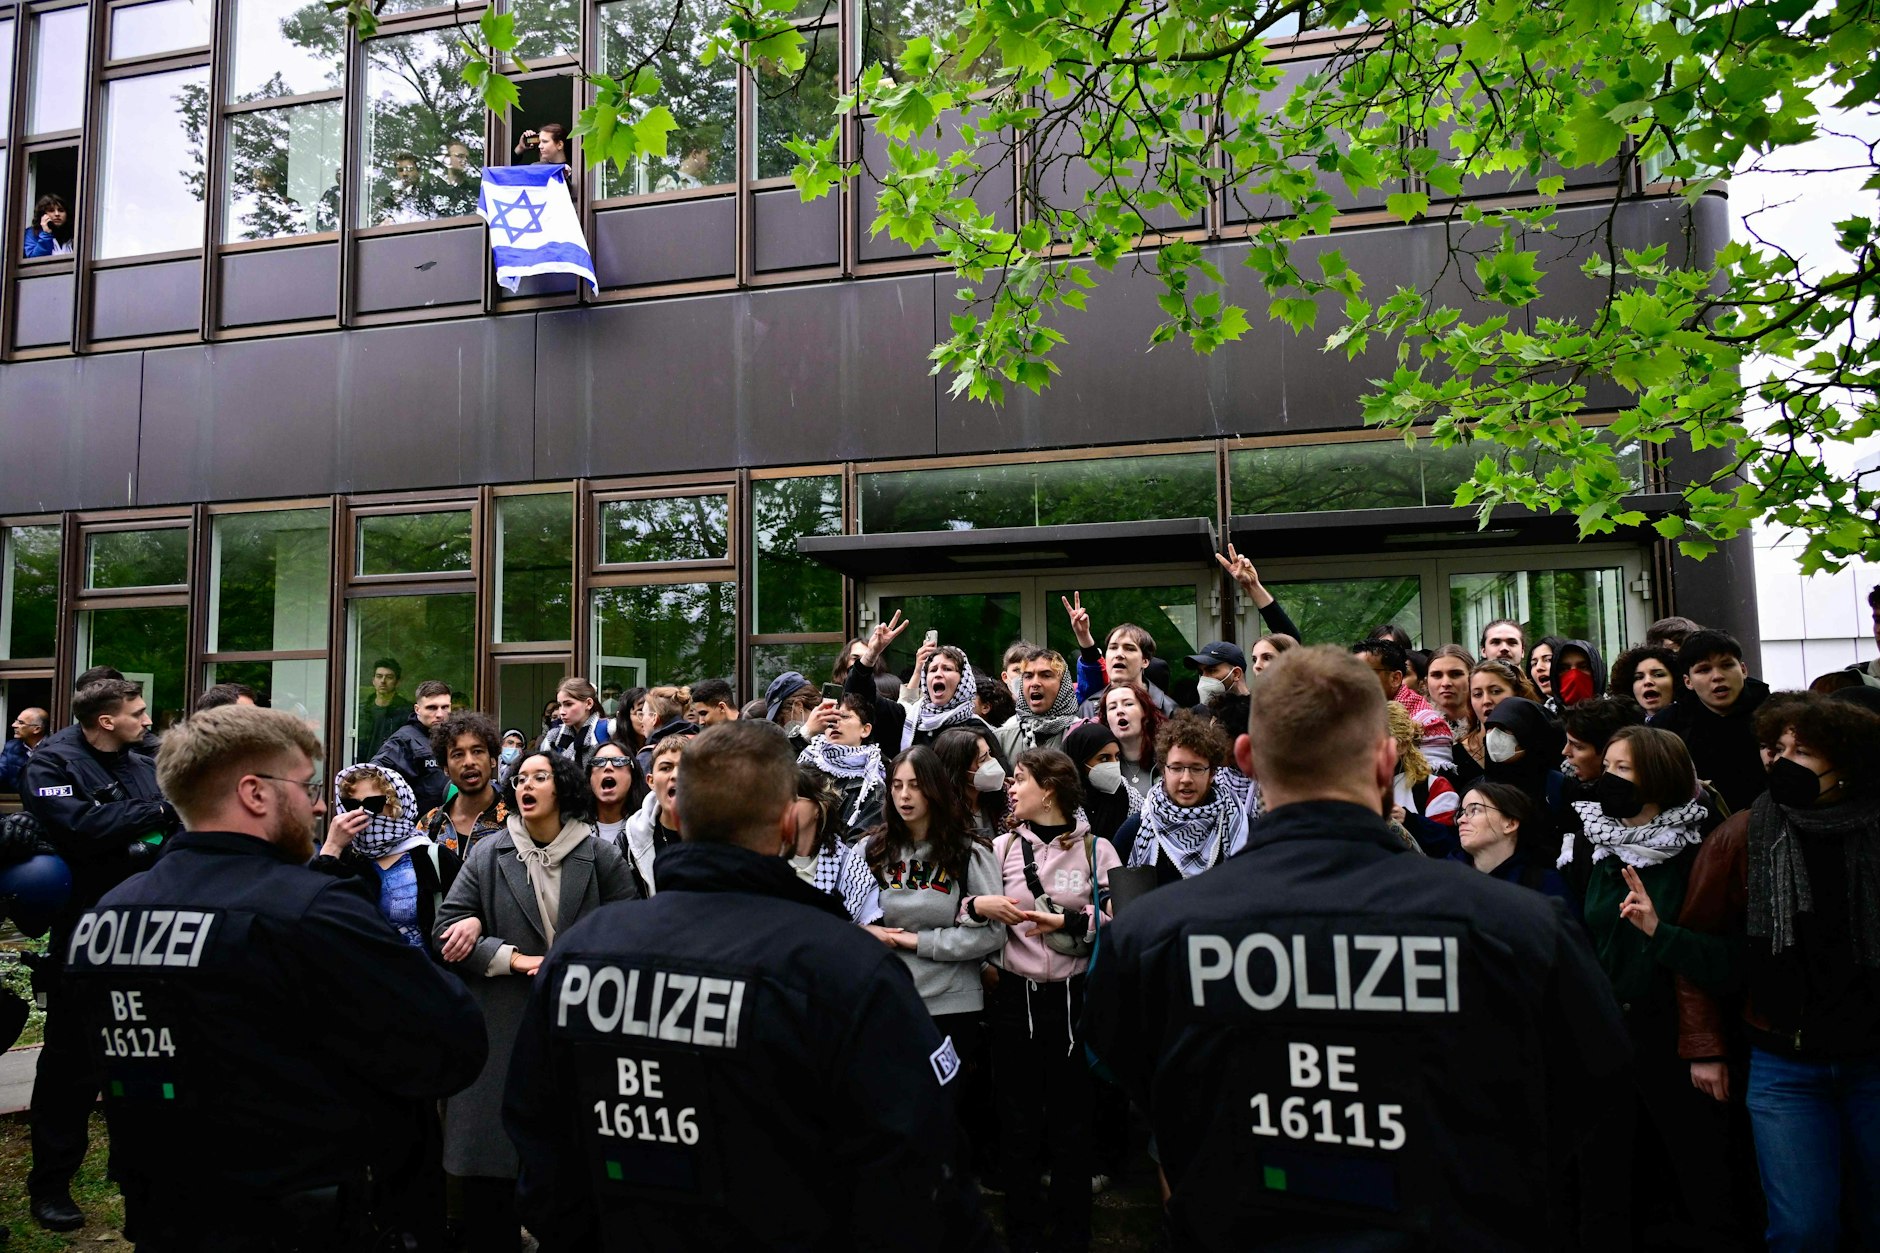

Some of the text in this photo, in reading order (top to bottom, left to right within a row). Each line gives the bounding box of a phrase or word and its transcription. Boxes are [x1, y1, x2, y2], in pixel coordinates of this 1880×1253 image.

[424, 759, 439, 768] POL
[45, 786, 68, 796] BFE
[68, 909, 215, 967] POLIZEI
[1187, 932, 1460, 1013] POLIZEI
[110, 990, 147, 1021] BE
[557, 964, 746, 1048] POLIZEI
[101, 1026, 177, 1058] 16124
[617, 1057, 664, 1098] BE
[1288, 1042, 1359, 1092] BE
[594, 1100, 699, 1145] 16116
[1250, 1093, 1406, 1150] 16115
